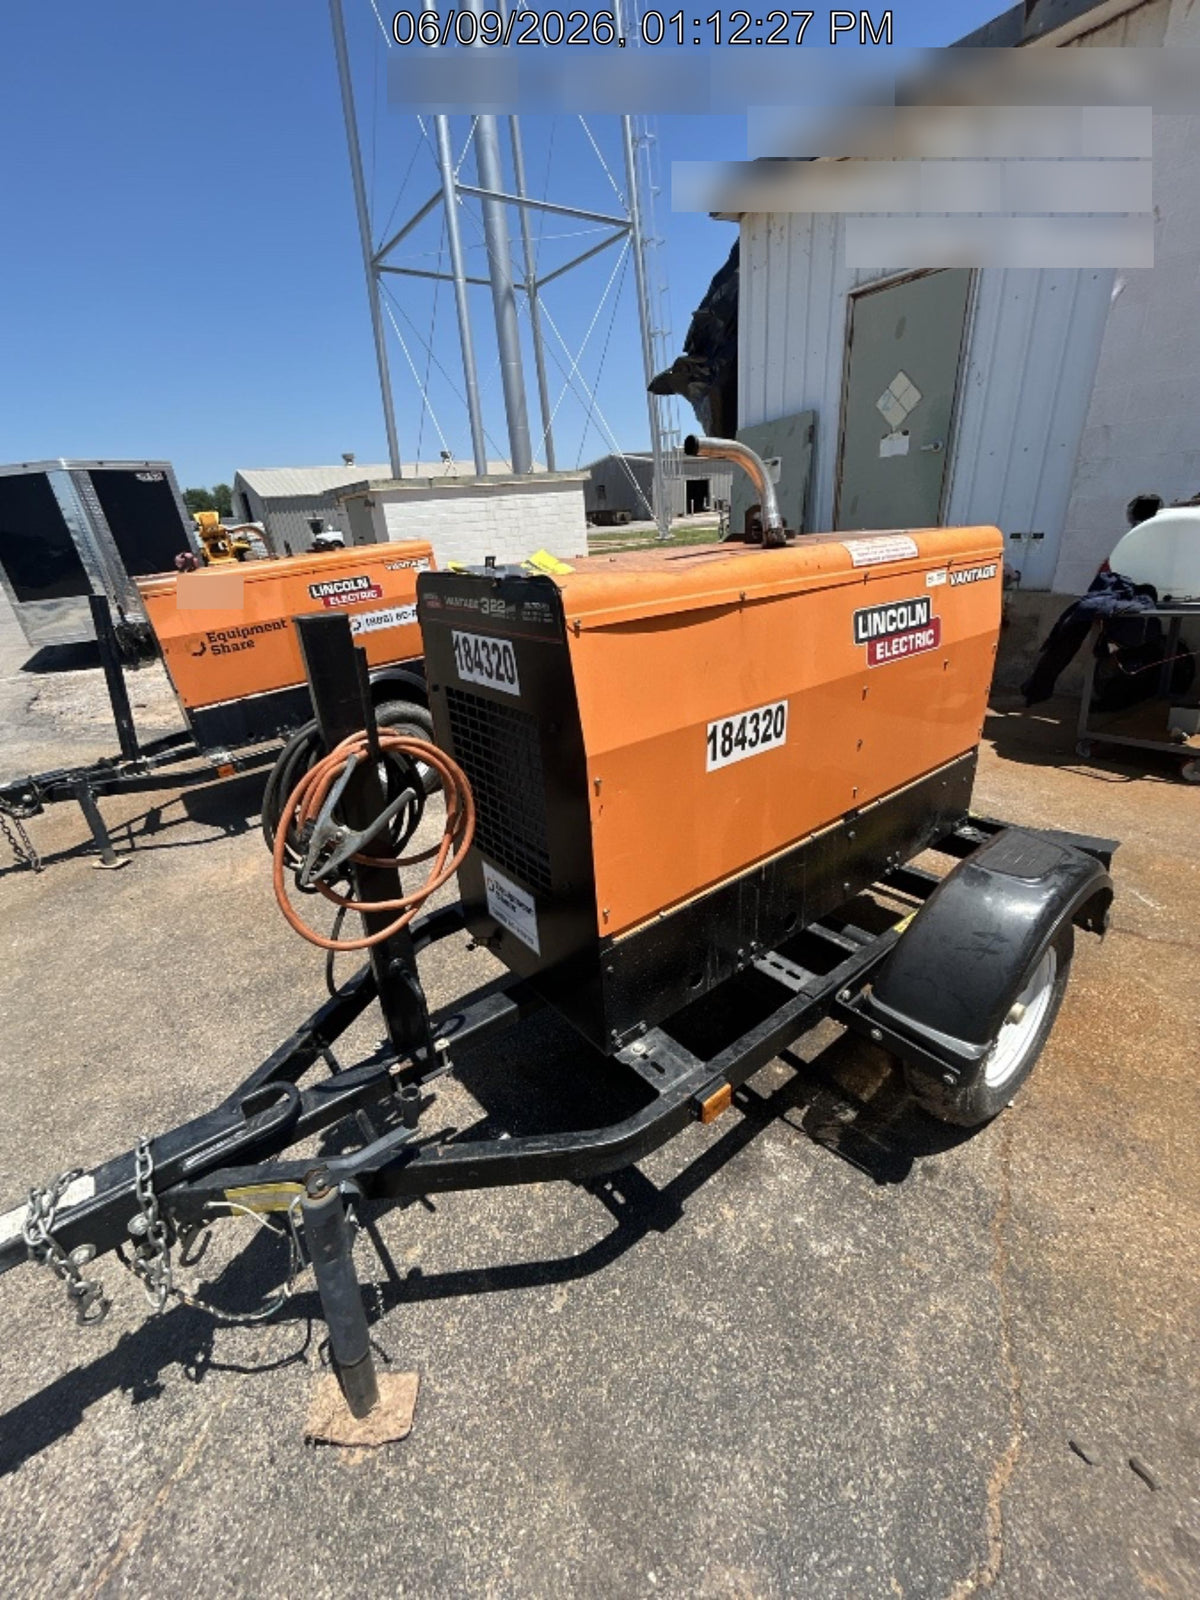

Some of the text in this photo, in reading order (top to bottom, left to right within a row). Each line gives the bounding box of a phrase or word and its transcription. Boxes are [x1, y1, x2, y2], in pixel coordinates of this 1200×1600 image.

[311, 577, 369, 597] LINCOLN
[949, 564, 997, 587] VANTAGE
[329, 589, 378, 605] ELECTRIC
[206, 618, 288, 643] Equipment
[857, 602, 928, 639] LINCOLN
[210, 639, 256, 656] Share
[875, 629, 935, 660] ELECTRIC
[453, 633, 517, 685] 184320
[707, 703, 785, 761] 184320
